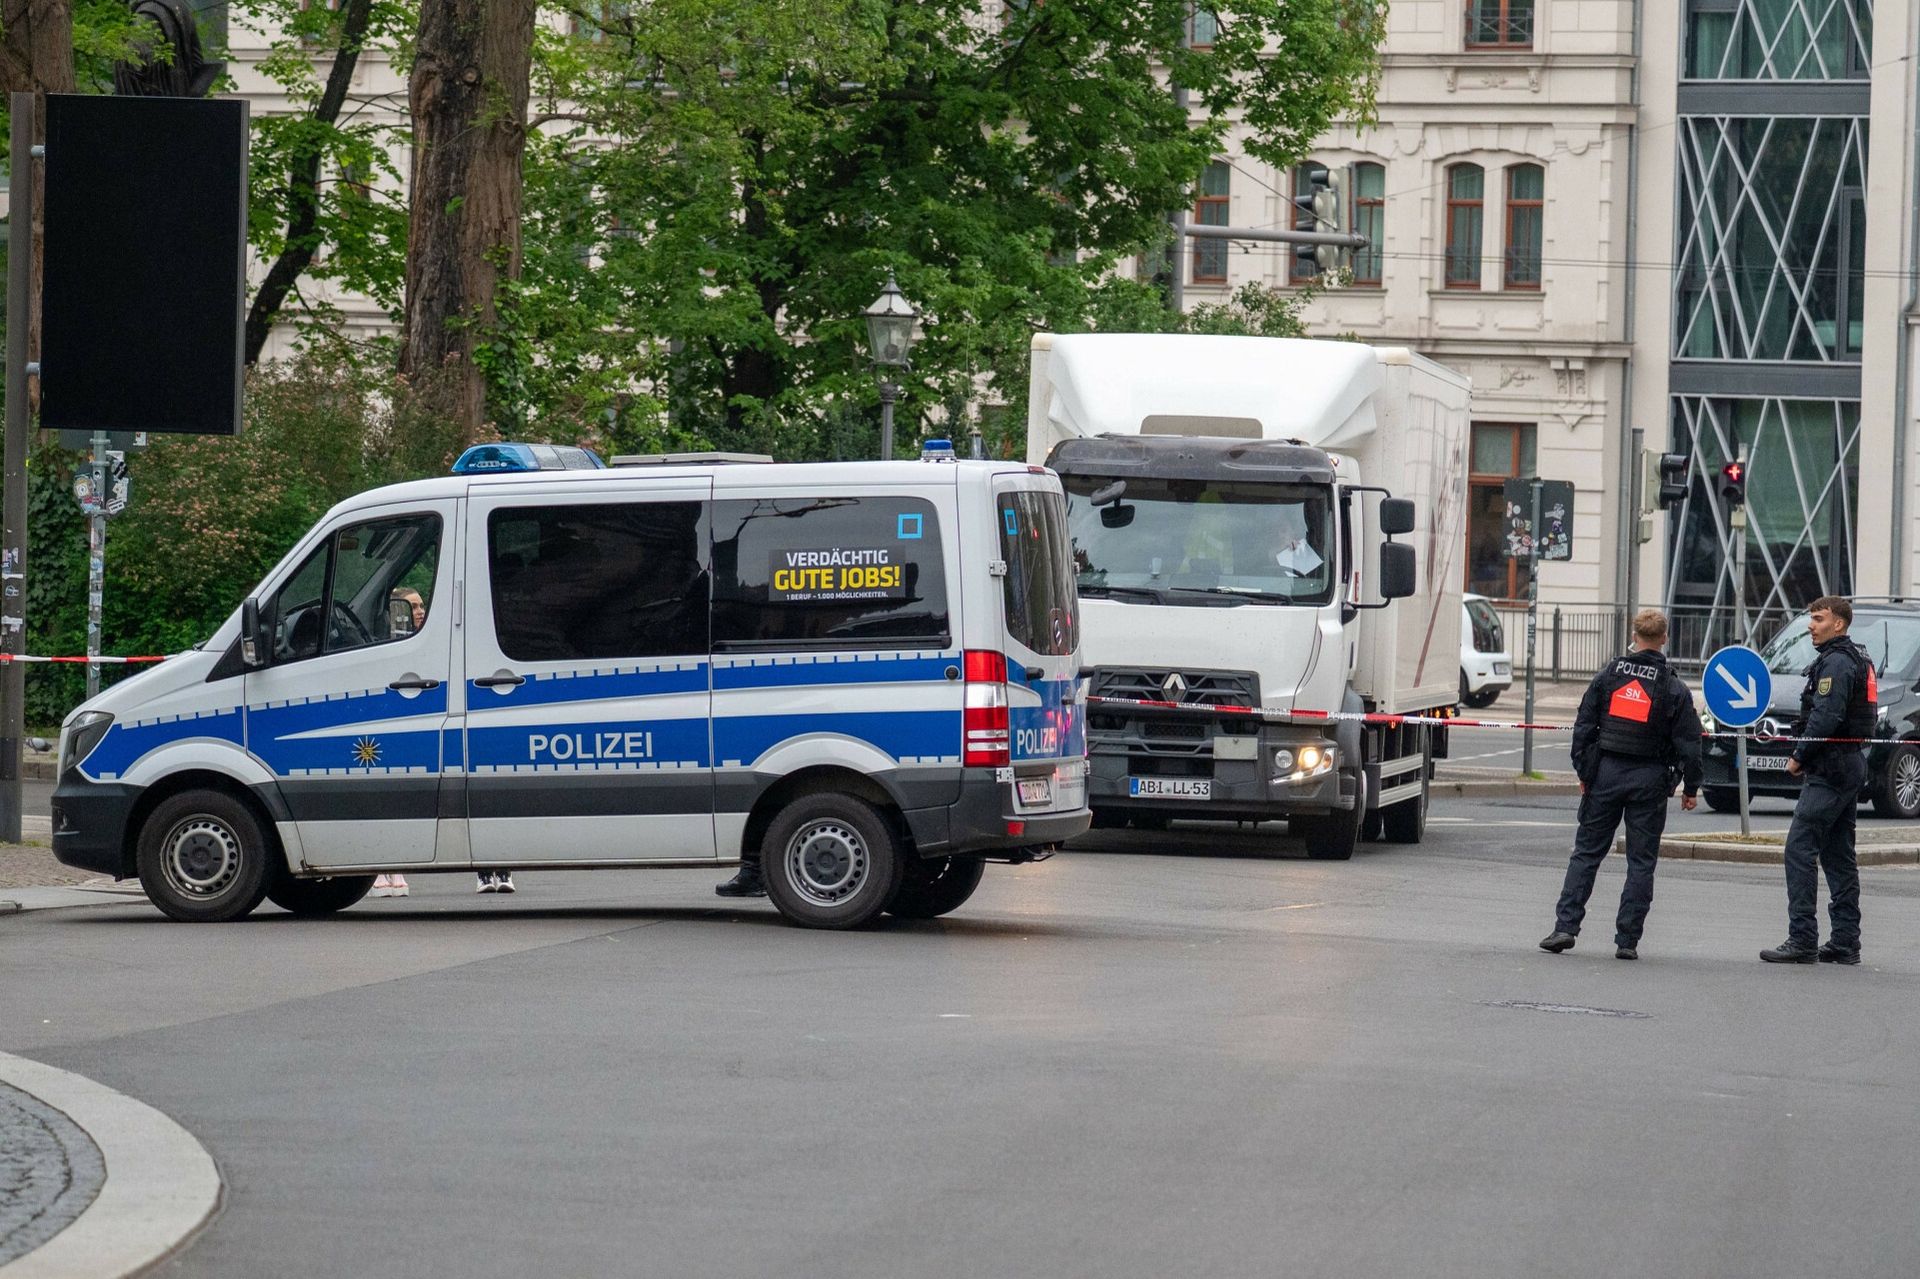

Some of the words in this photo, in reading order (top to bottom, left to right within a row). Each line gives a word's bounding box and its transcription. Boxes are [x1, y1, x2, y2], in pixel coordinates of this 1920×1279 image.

[786, 548, 888, 567] VERDÄCHTIG
[774, 568, 834, 591] GUTE
[840, 566, 900, 590] JOBS!
[835, 591, 888, 599] MÖGLICHKEITEN.
[1615, 661, 1658, 681] POLIZEI
[1625, 687, 1641, 699] SN
[529, 732, 653, 760] POLIZEI
[1016, 727, 1057, 755] POLIZEI
